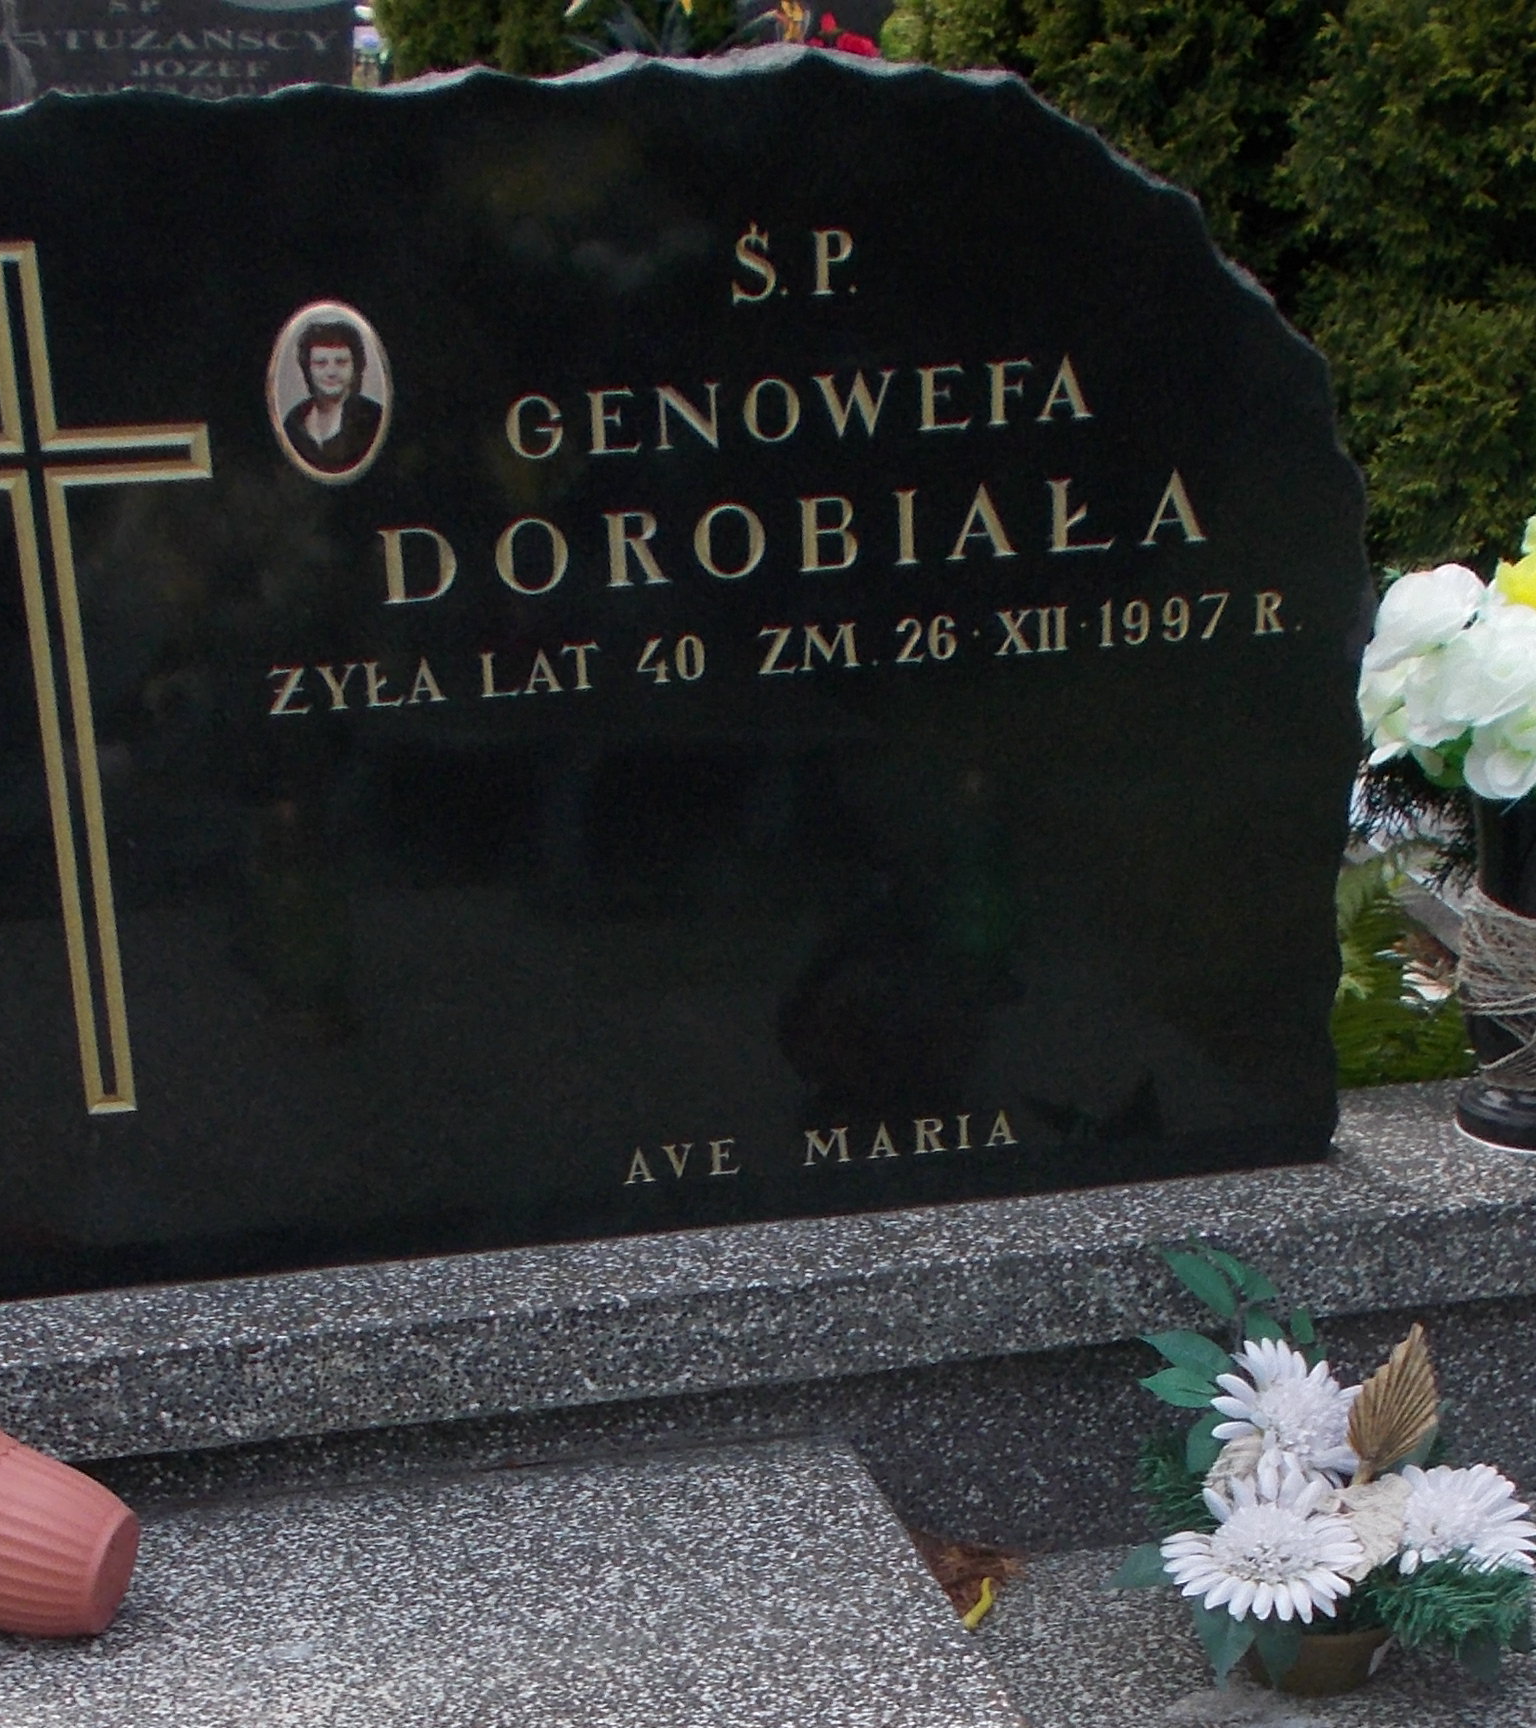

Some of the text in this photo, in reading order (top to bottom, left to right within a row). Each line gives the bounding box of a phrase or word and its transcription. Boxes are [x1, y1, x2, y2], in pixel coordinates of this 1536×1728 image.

[505, 354, 1094, 460] GENOWEFA
[378, 468, 1207, 605] DOROBIAŁA
[478, 639, 601, 698] LAT
[637, 634, 705, 684] 40
[623, 1109, 1020, 1185] AVE MARIA
